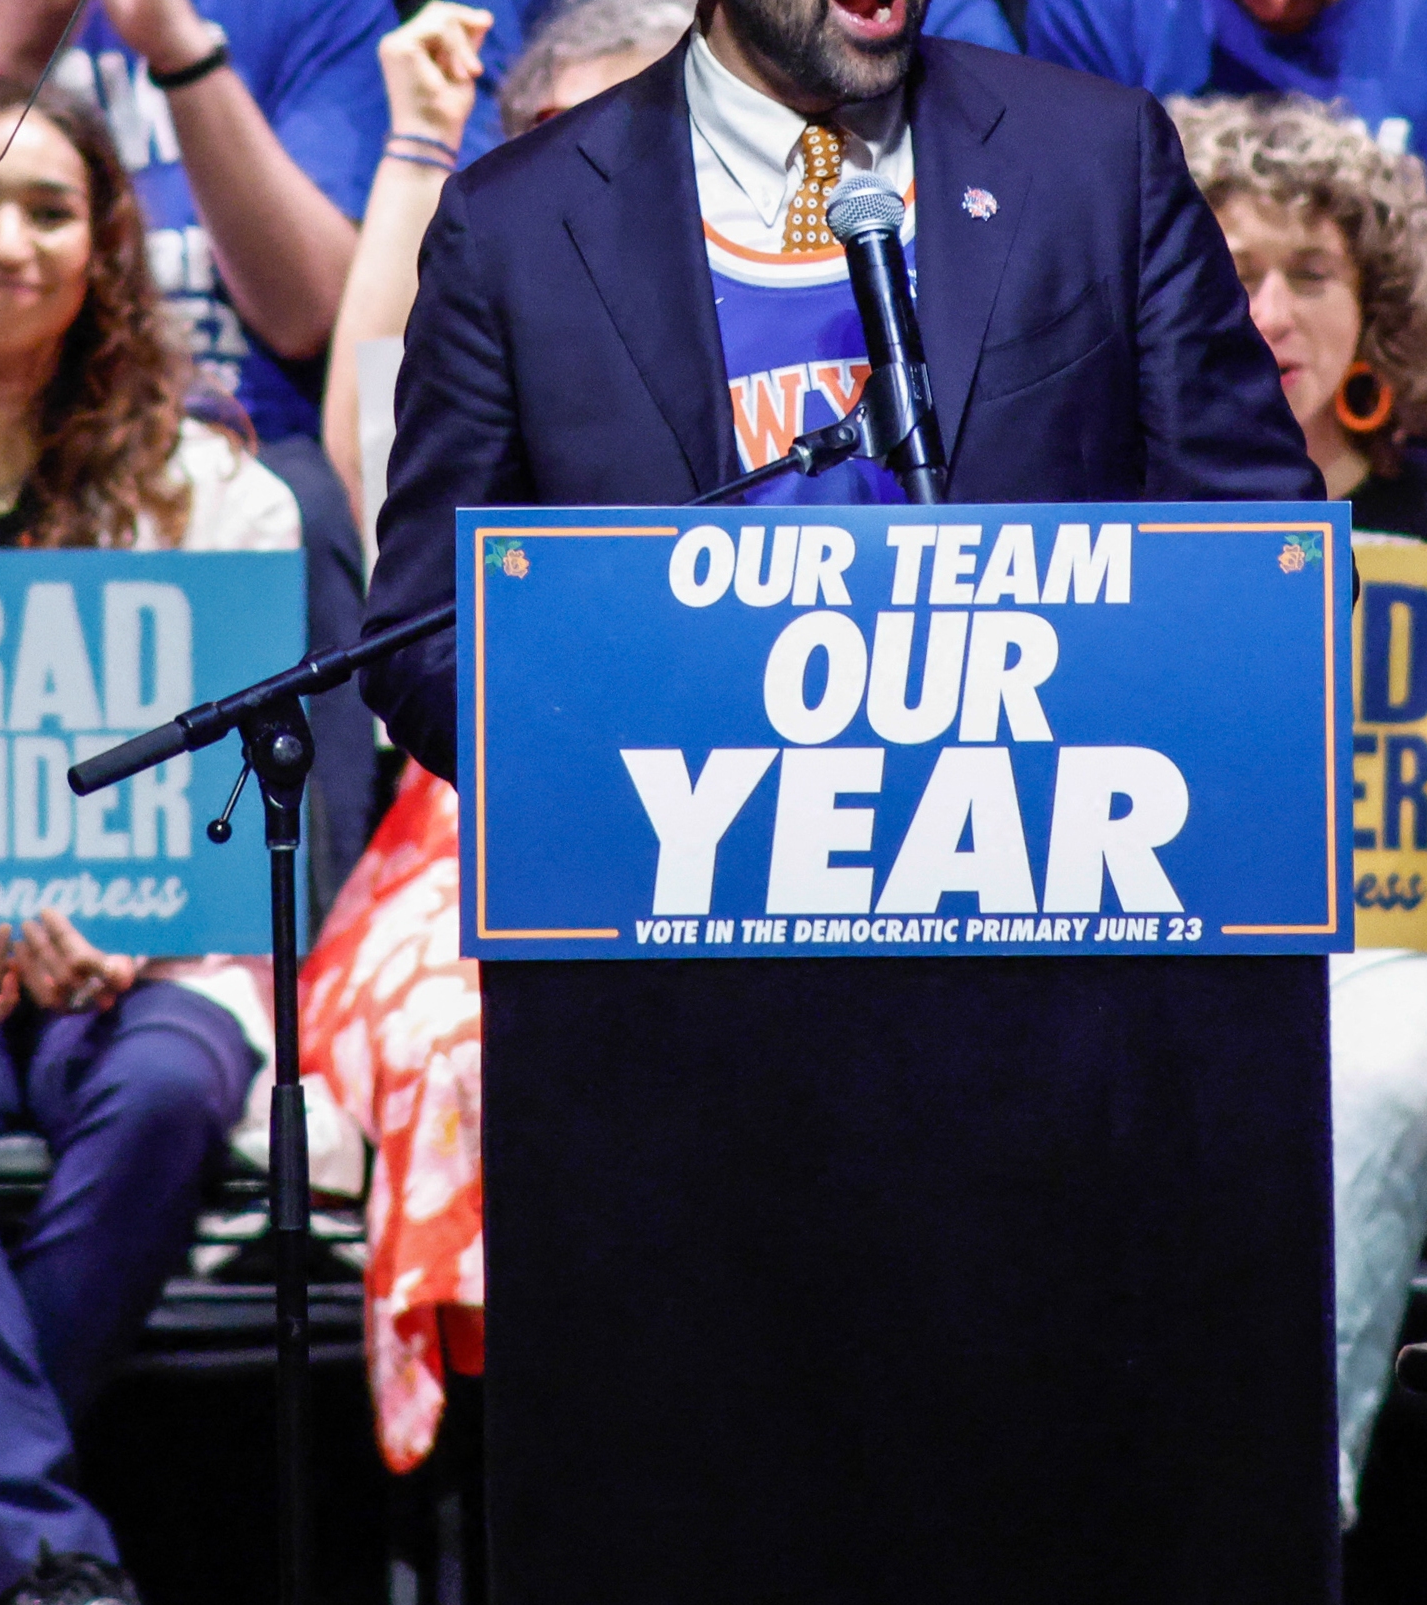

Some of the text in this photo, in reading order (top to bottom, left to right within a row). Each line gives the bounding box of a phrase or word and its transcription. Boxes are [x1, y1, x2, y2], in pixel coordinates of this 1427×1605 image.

[668, 523, 1131, 608] OUR TEAM
[762, 611, 1059, 745] OUR
[620, 746, 1189, 915] YEAR
[635, 917, 1203, 945] VOTE IN THE DEMOCRATIC PRIMARY JUNE 23
